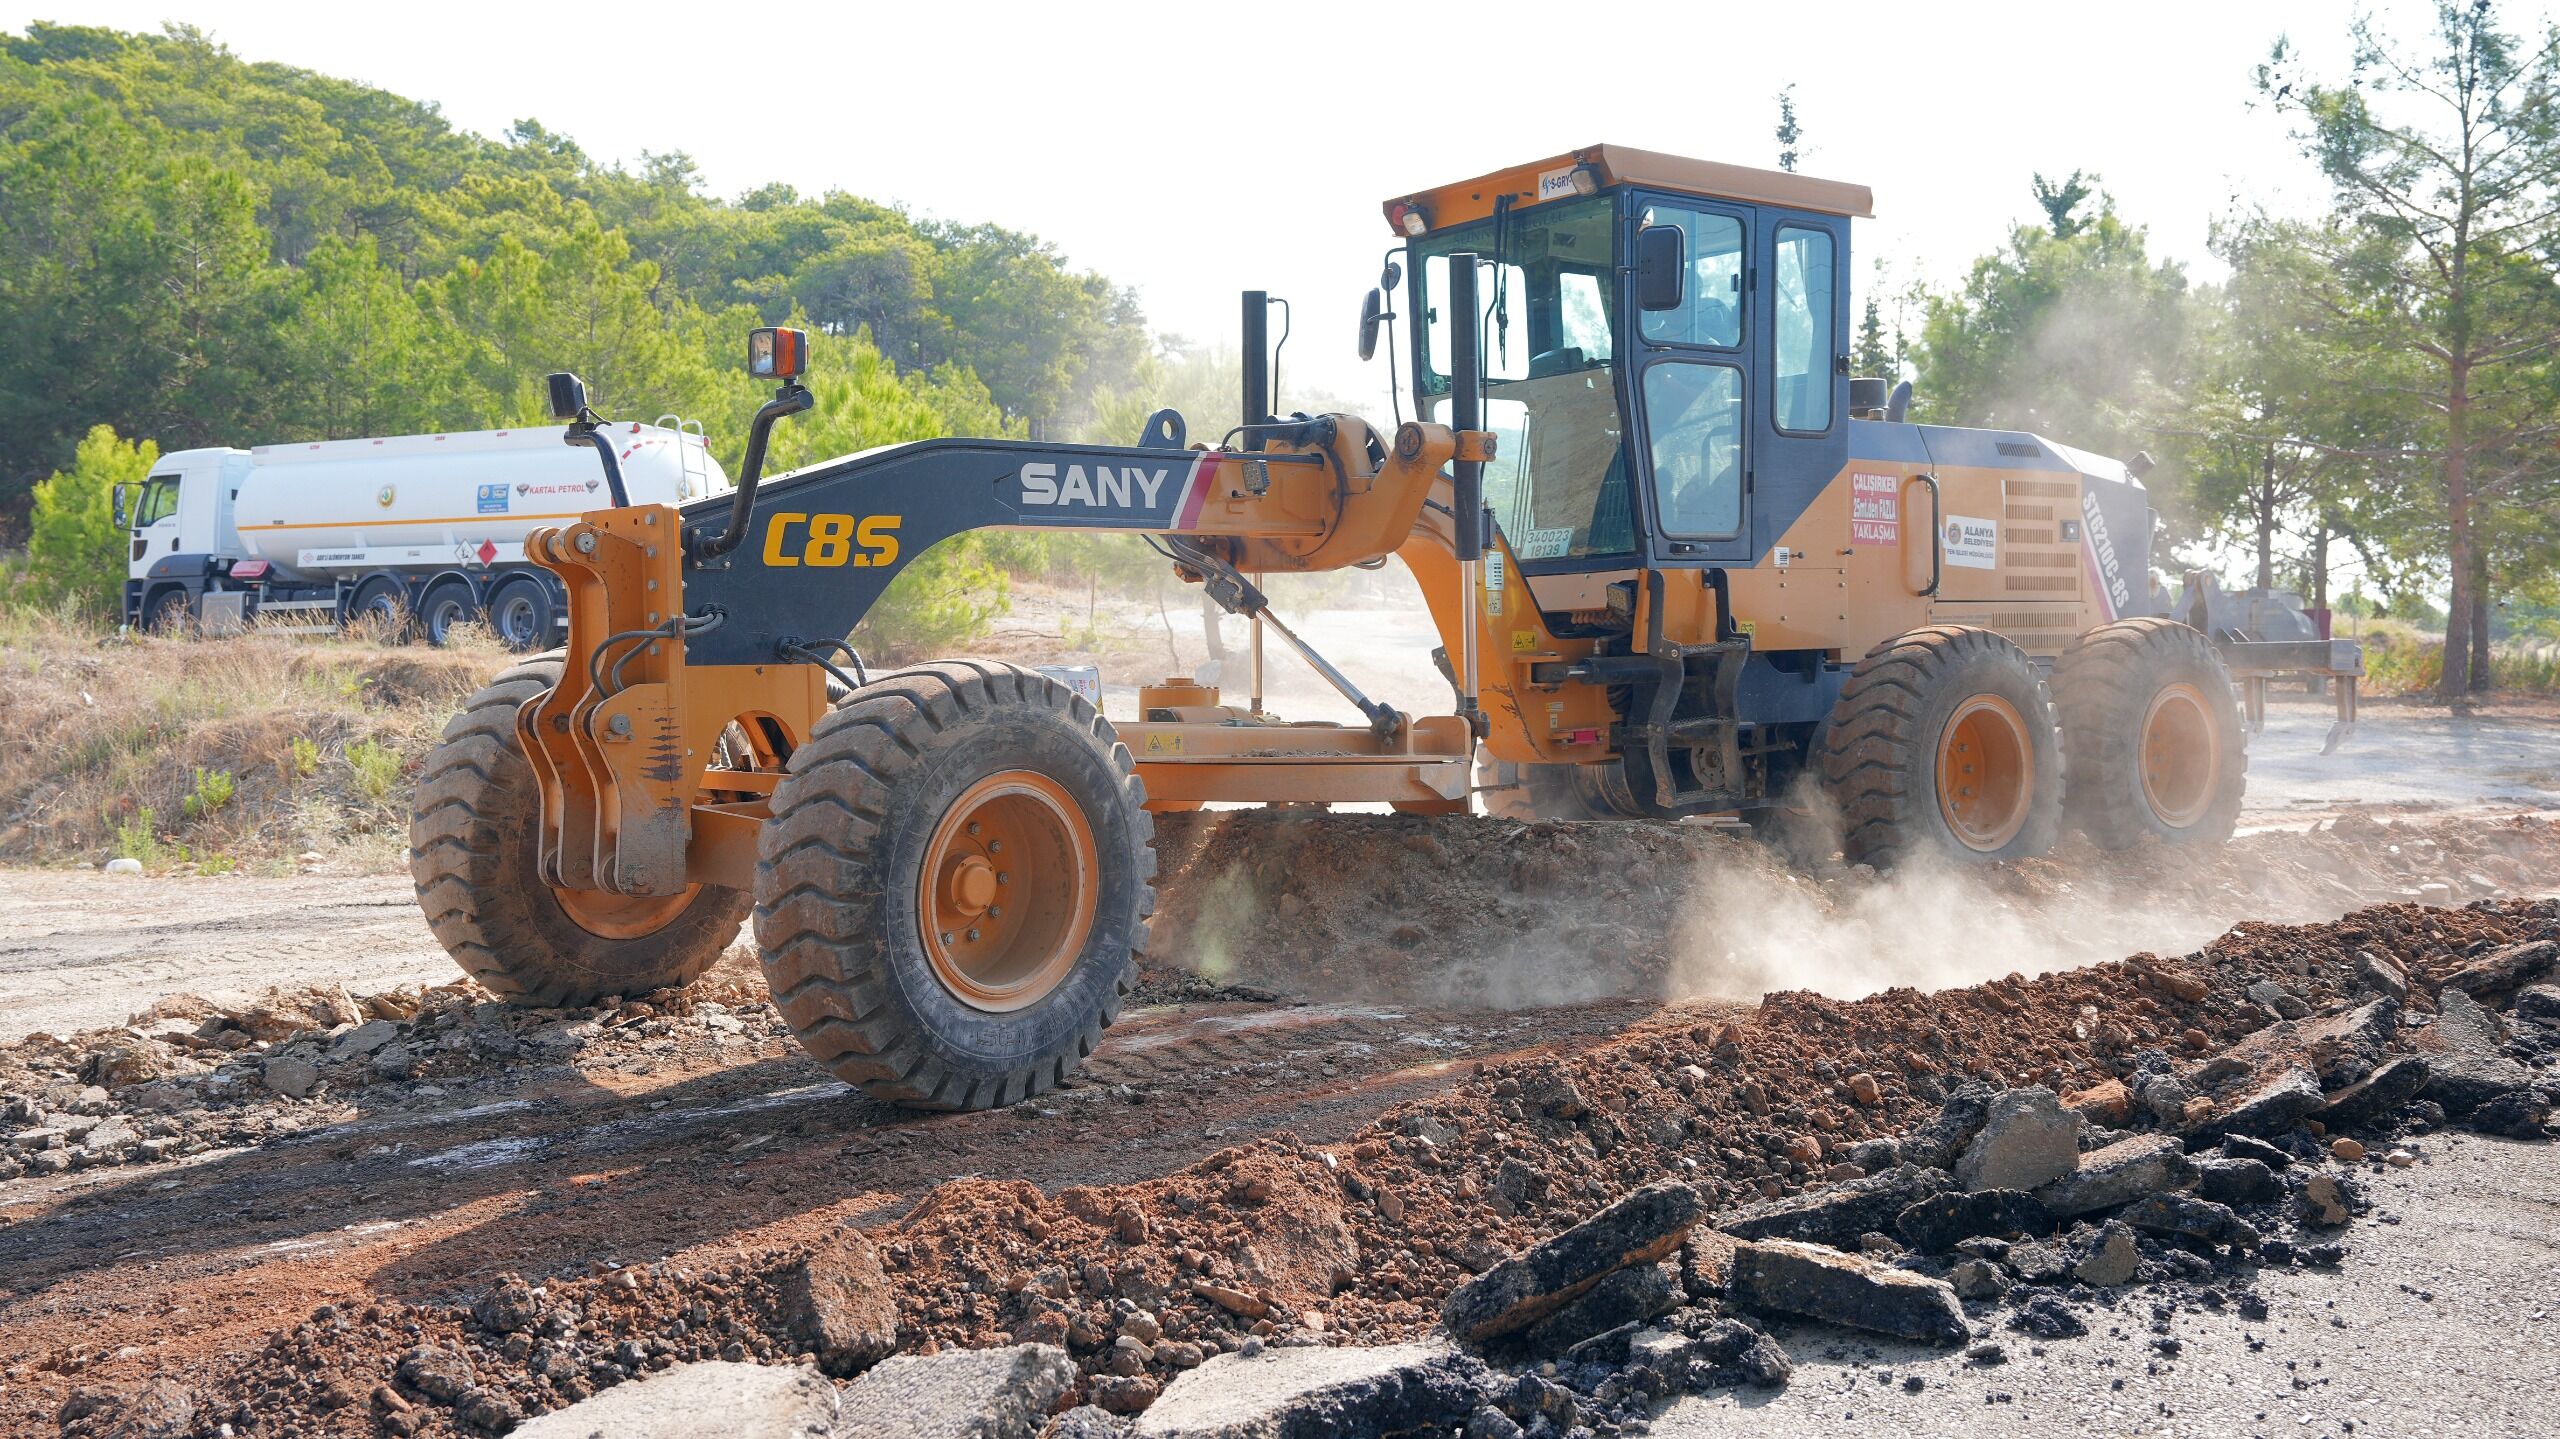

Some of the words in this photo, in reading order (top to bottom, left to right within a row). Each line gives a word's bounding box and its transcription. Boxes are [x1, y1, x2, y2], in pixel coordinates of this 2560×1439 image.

[529, 486, 556, 494] KARTAL
[558, 484, 585, 493] PETROL
[1021, 462, 1168, 508] SANY
[1853, 473, 1897, 496] ÇALIŞIRKEN
[1880, 499, 1896, 520] FAZLA
[762, 513, 901, 567] C8S
[1528, 529, 1570, 543] 340023
[1853, 523, 1896, 544] YAKLAŞMA
[1964, 526, 1994, 538] ALANYA
[1531, 544, 1560, 556] 18139
[2083, 491, 2129, 608] STG210C-8S
